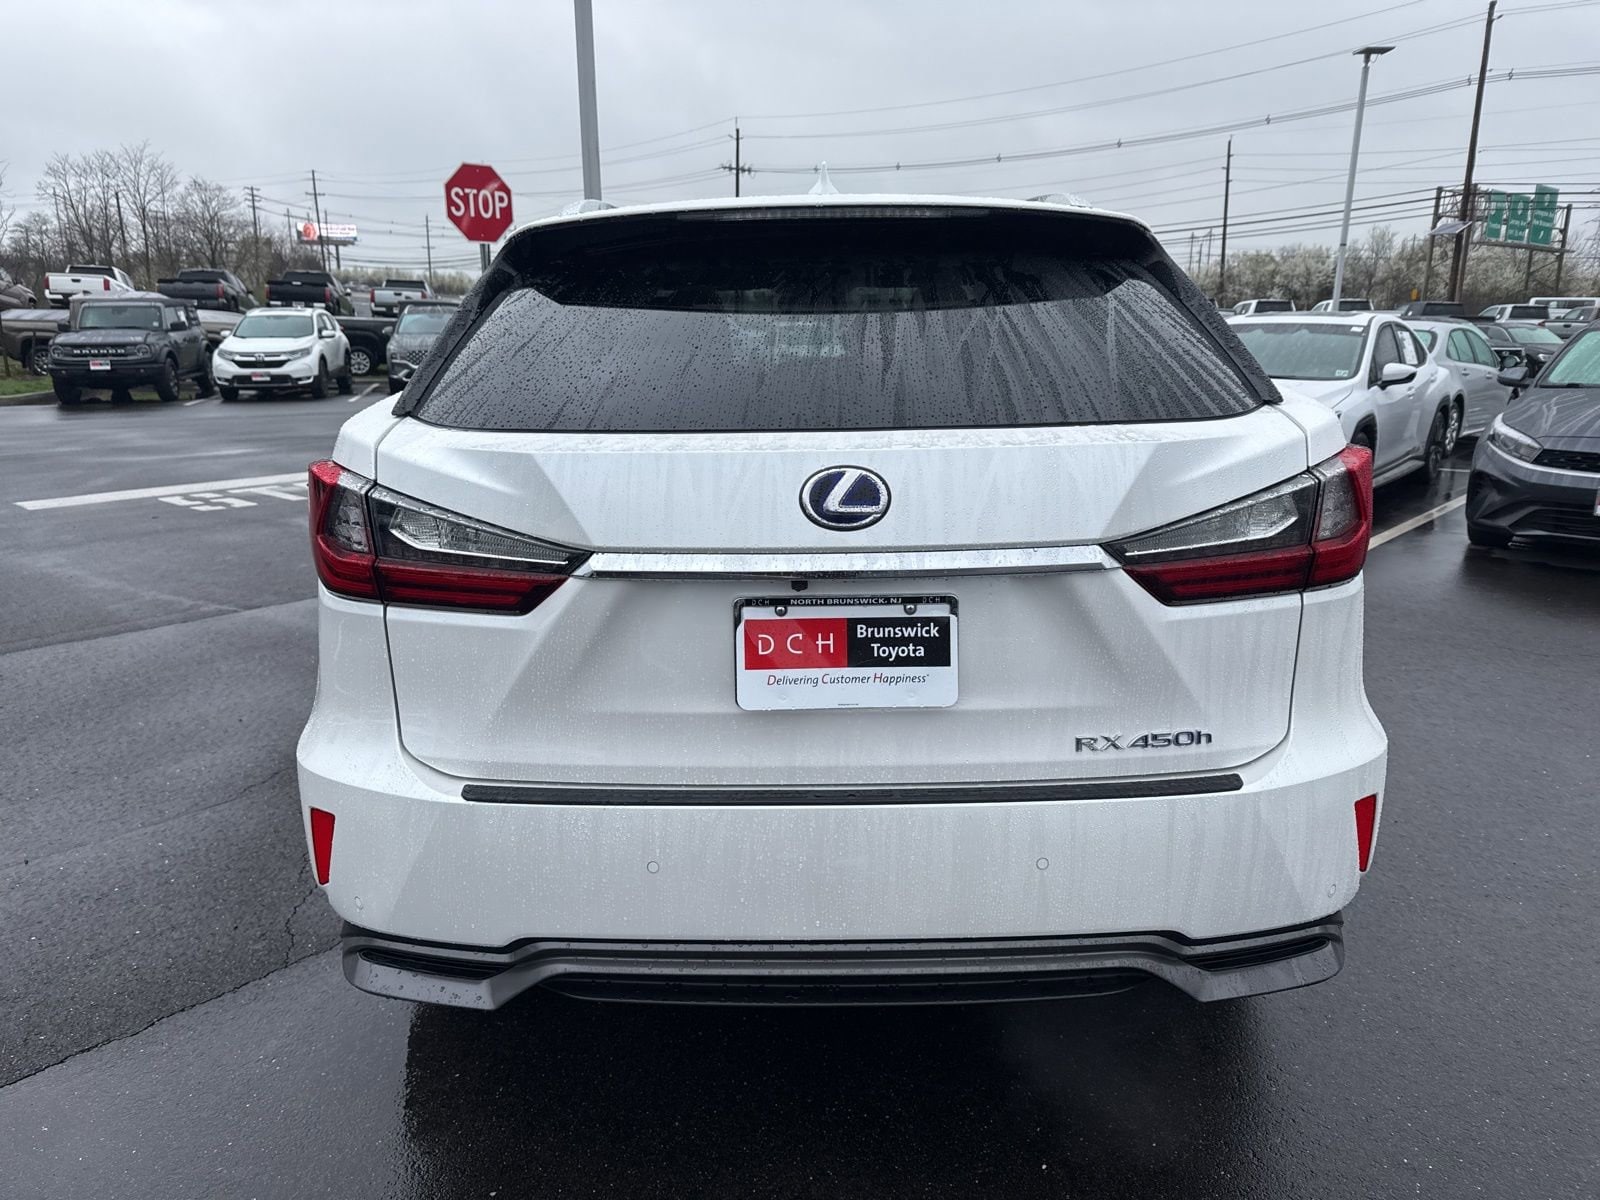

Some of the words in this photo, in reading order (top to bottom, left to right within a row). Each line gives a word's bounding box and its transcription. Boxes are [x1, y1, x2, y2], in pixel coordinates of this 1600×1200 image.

[450, 186, 509, 219] STOP
[856, 622, 940, 638] Brunswick
[870, 643, 925, 662] Toyota
[767, 674, 819, 688] Delivering
[821, 673, 871, 684] Customer
[873, 672, 927, 686] Happiness
[1074, 733, 1125, 752] RX
[1126, 729, 1213, 749] 450h
